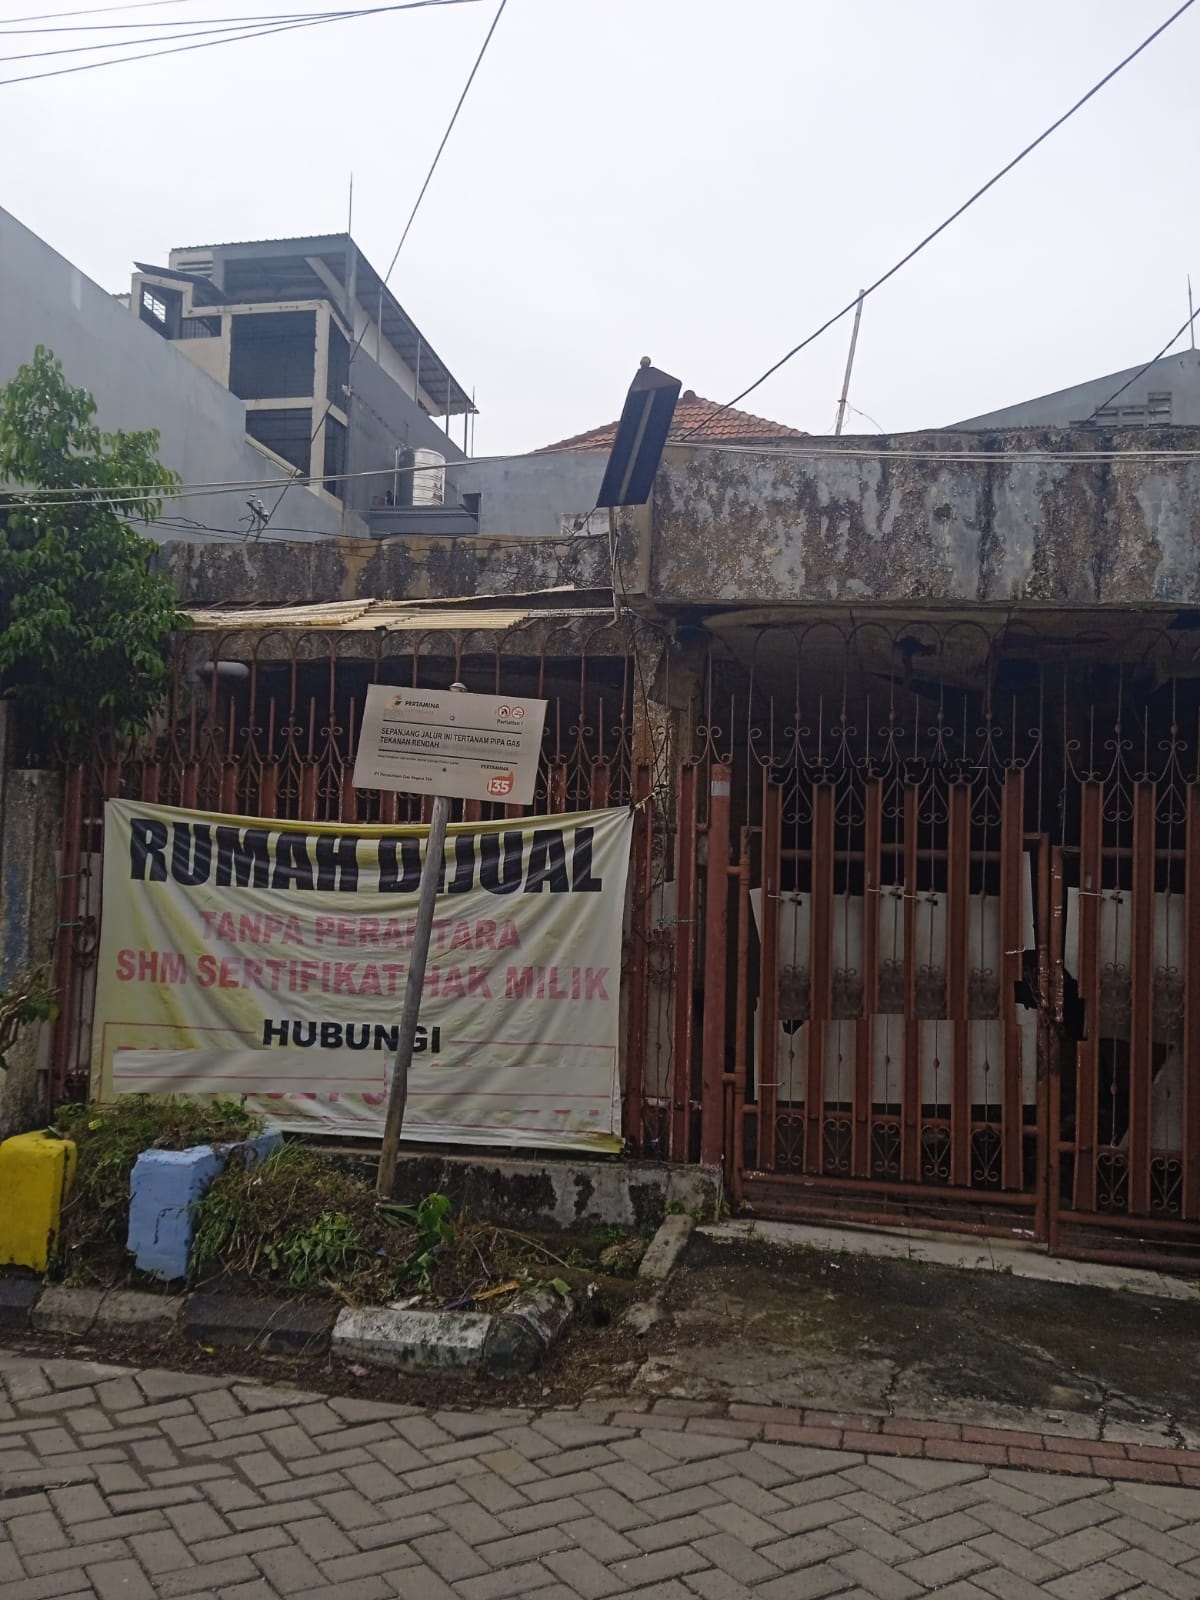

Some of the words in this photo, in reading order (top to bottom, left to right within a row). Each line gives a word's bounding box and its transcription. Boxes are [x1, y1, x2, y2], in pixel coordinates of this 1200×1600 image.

[404, 700, 440, 709] PERTAMINA
[380, 736, 411, 746] TEKANAN
[411, 739, 440, 749] RENDAH
[381, 727, 420, 738] SEPANJANG
[421, 731, 442, 740] JALUR
[443, 733, 453, 741] INI
[454, 734, 489, 745] TERTANAM
[490, 737, 505, 746] PIPA
[506, 739, 521, 748] GAS
[488, 778, 509, 793] 135
[130, 818, 359, 892] RUMAH
[202, 911, 304, 945] TANPA
[116, 949, 187, 985] SHM
[196, 954, 404, 996] SERTIFIKAT
[422, 964, 494, 999] HAK
[504, 965, 611, 1001] MILIK
[262, 1018, 440, 1054] HUBUNGI
